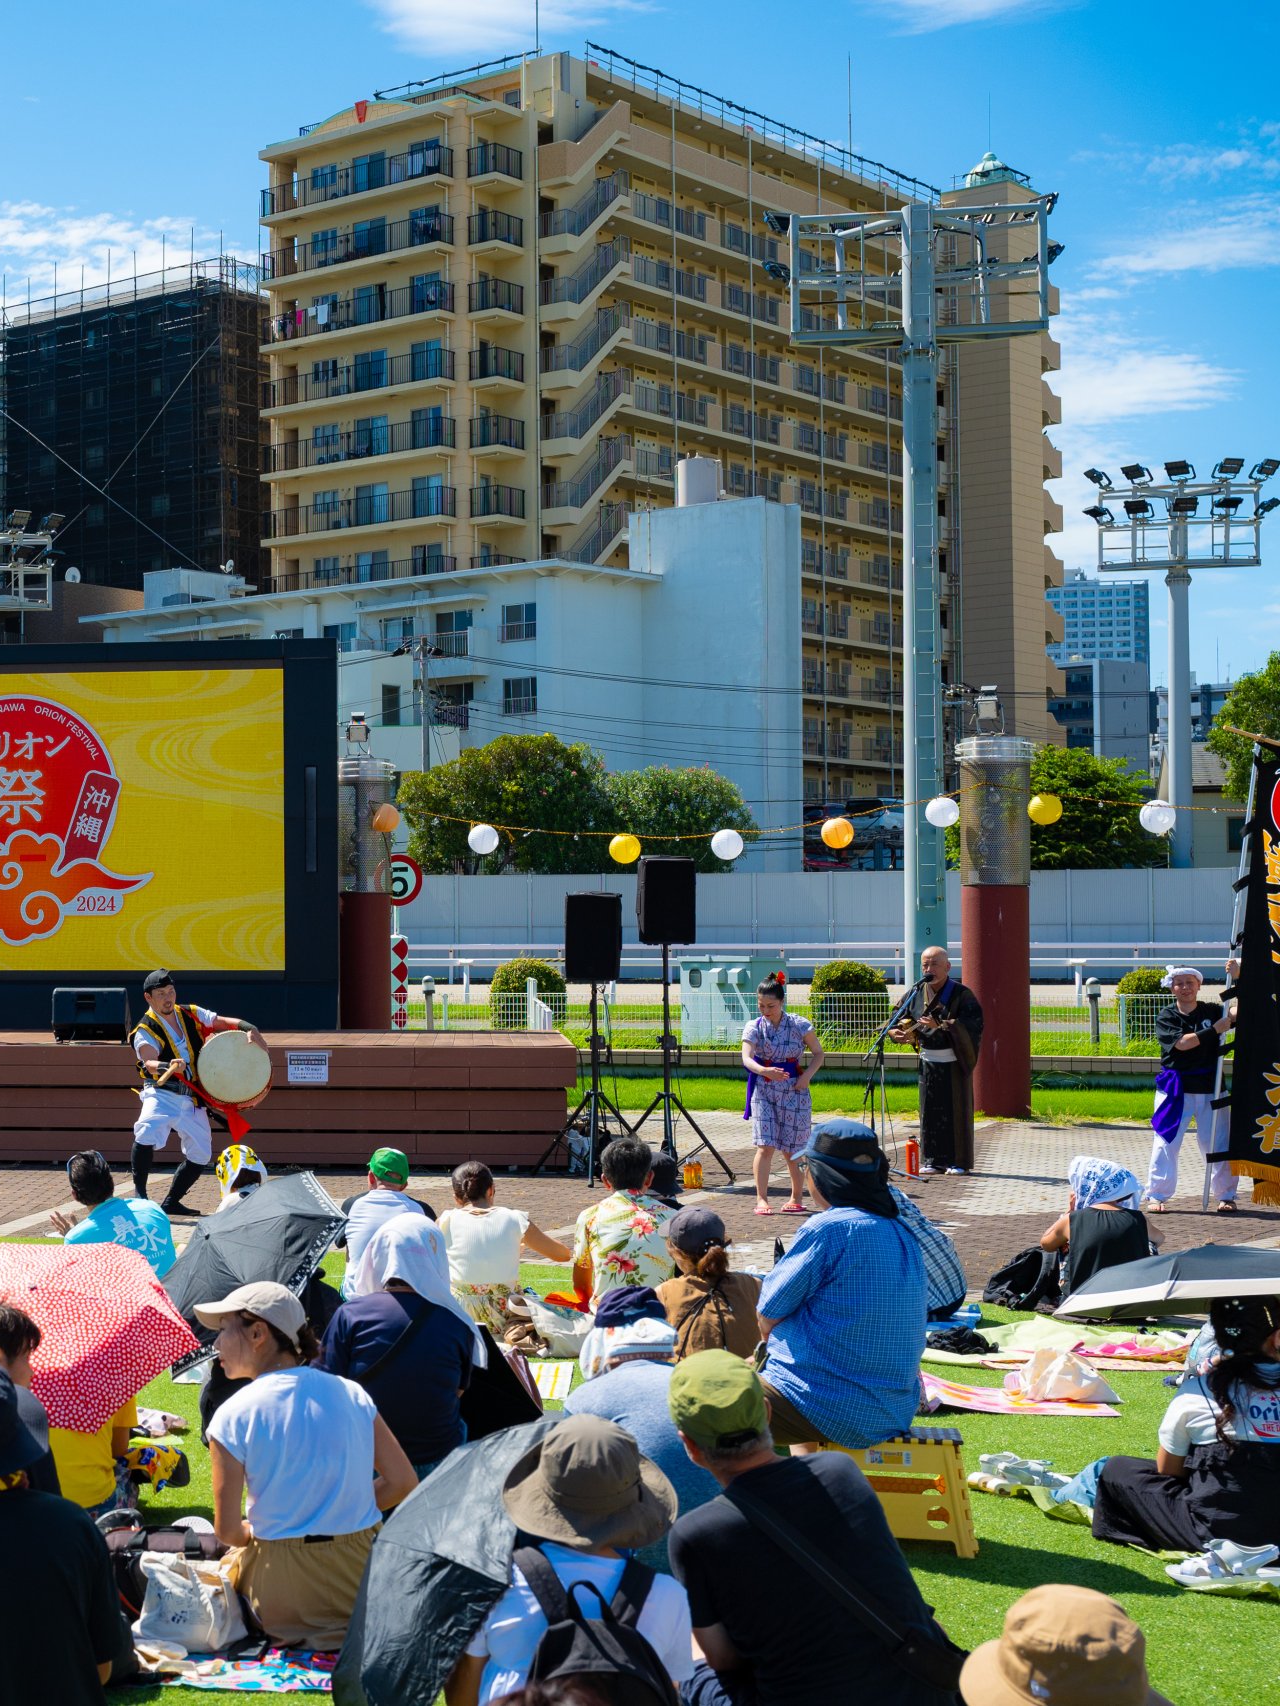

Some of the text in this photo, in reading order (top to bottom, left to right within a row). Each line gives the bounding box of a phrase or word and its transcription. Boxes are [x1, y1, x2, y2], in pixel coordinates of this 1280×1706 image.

[34, 705, 66, 725] ORION
[66, 720, 102, 761] FESTIVAL
[73, 785, 113, 843] 沖縄
[76, 895, 117, 912] 2024
[925, 926, 932, 936] 3
[1250, 1402, 1280, 1421] Ori
